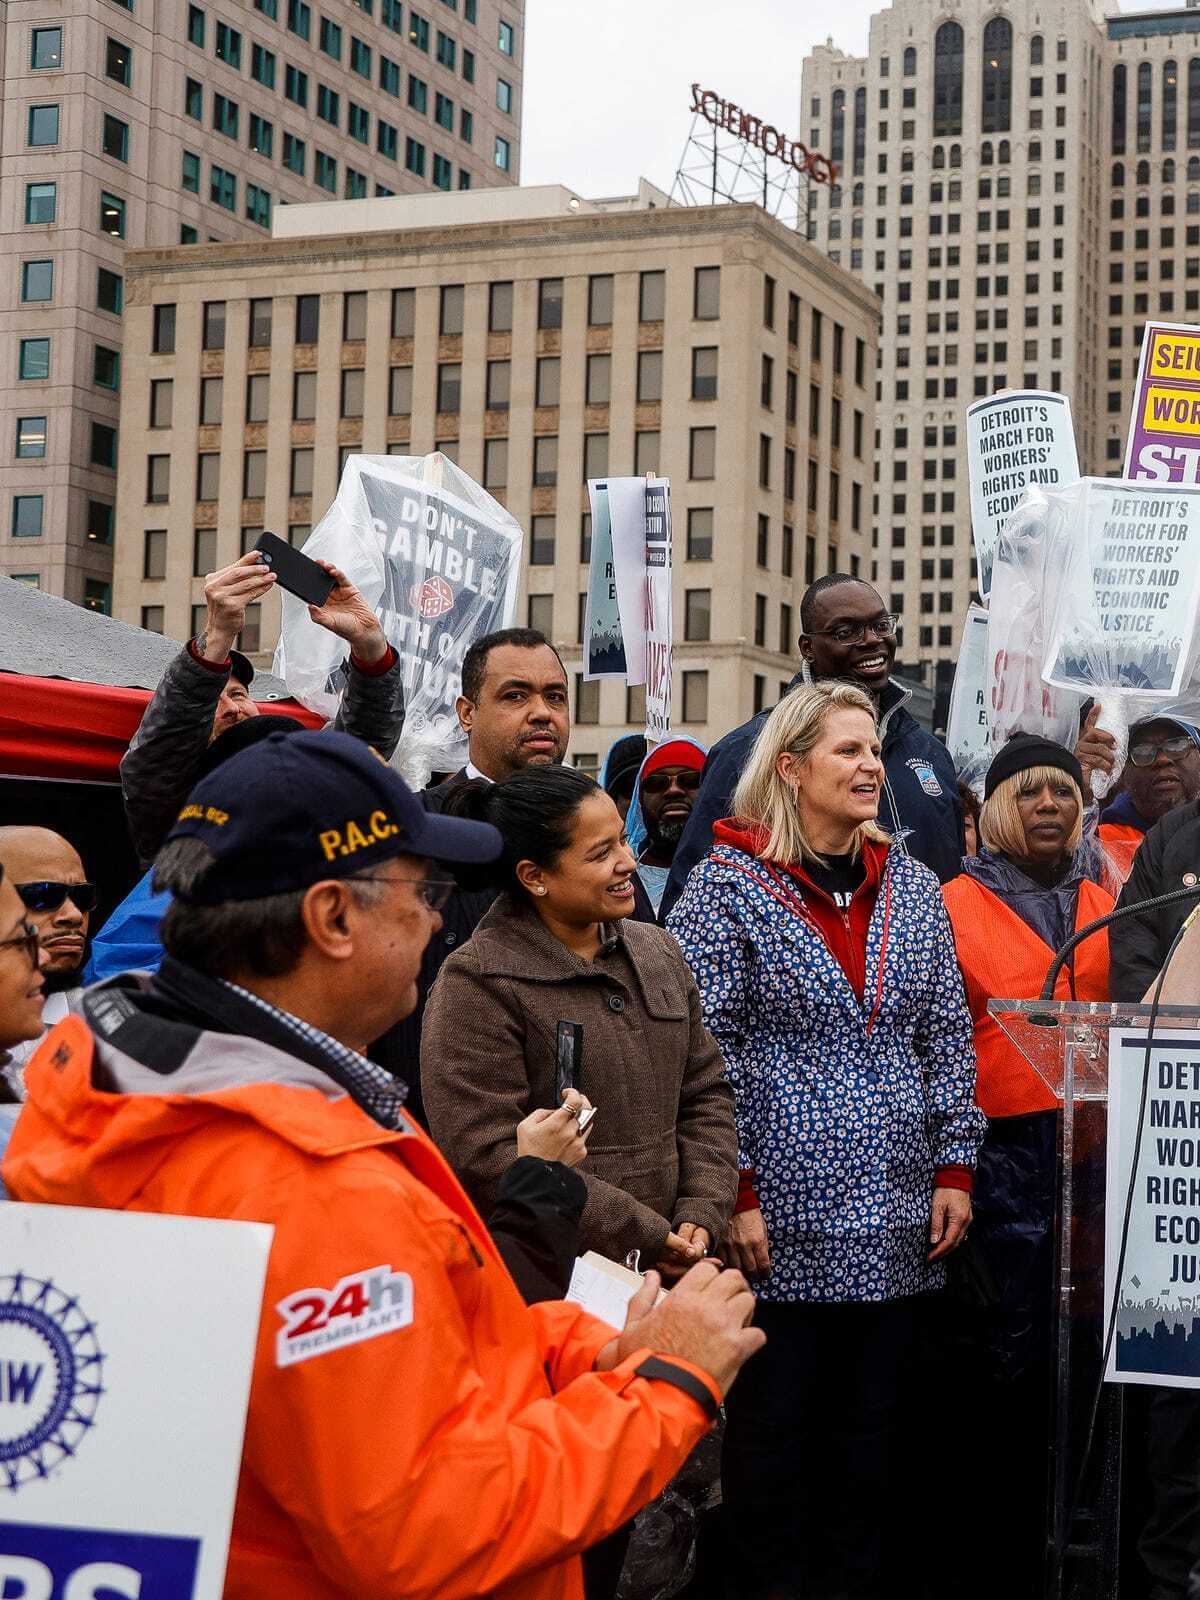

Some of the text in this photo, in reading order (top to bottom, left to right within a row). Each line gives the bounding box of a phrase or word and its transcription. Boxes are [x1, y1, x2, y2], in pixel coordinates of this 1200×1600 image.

[689, 84, 838, 186] SCIENTOLOGY
[981, 406, 1048, 432] DETROIT'S
[980, 427, 1054, 454] MARCH FOR
[984, 447, 1051, 474] WORKERS'
[982, 468, 1059, 497] RIGHTS AND
[988, 493, 1023, 516] ECON
[1111, 499, 1189, 518] DETROIT'S
[401, 497, 477, 550] DON'T
[1103, 522, 1188, 541] MARCH FOR
[373, 517, 498, 598] GAMBLE
[1104, 545, 1179, 563] WORKERS'
[1093, 568, 1180, 587] RIGHTS AND
[319, 809, 399, 861] P.A.C.
[287, 1277, 404, 1339] 24h
[288, 1309, 404, 1355] TREMBLANT
